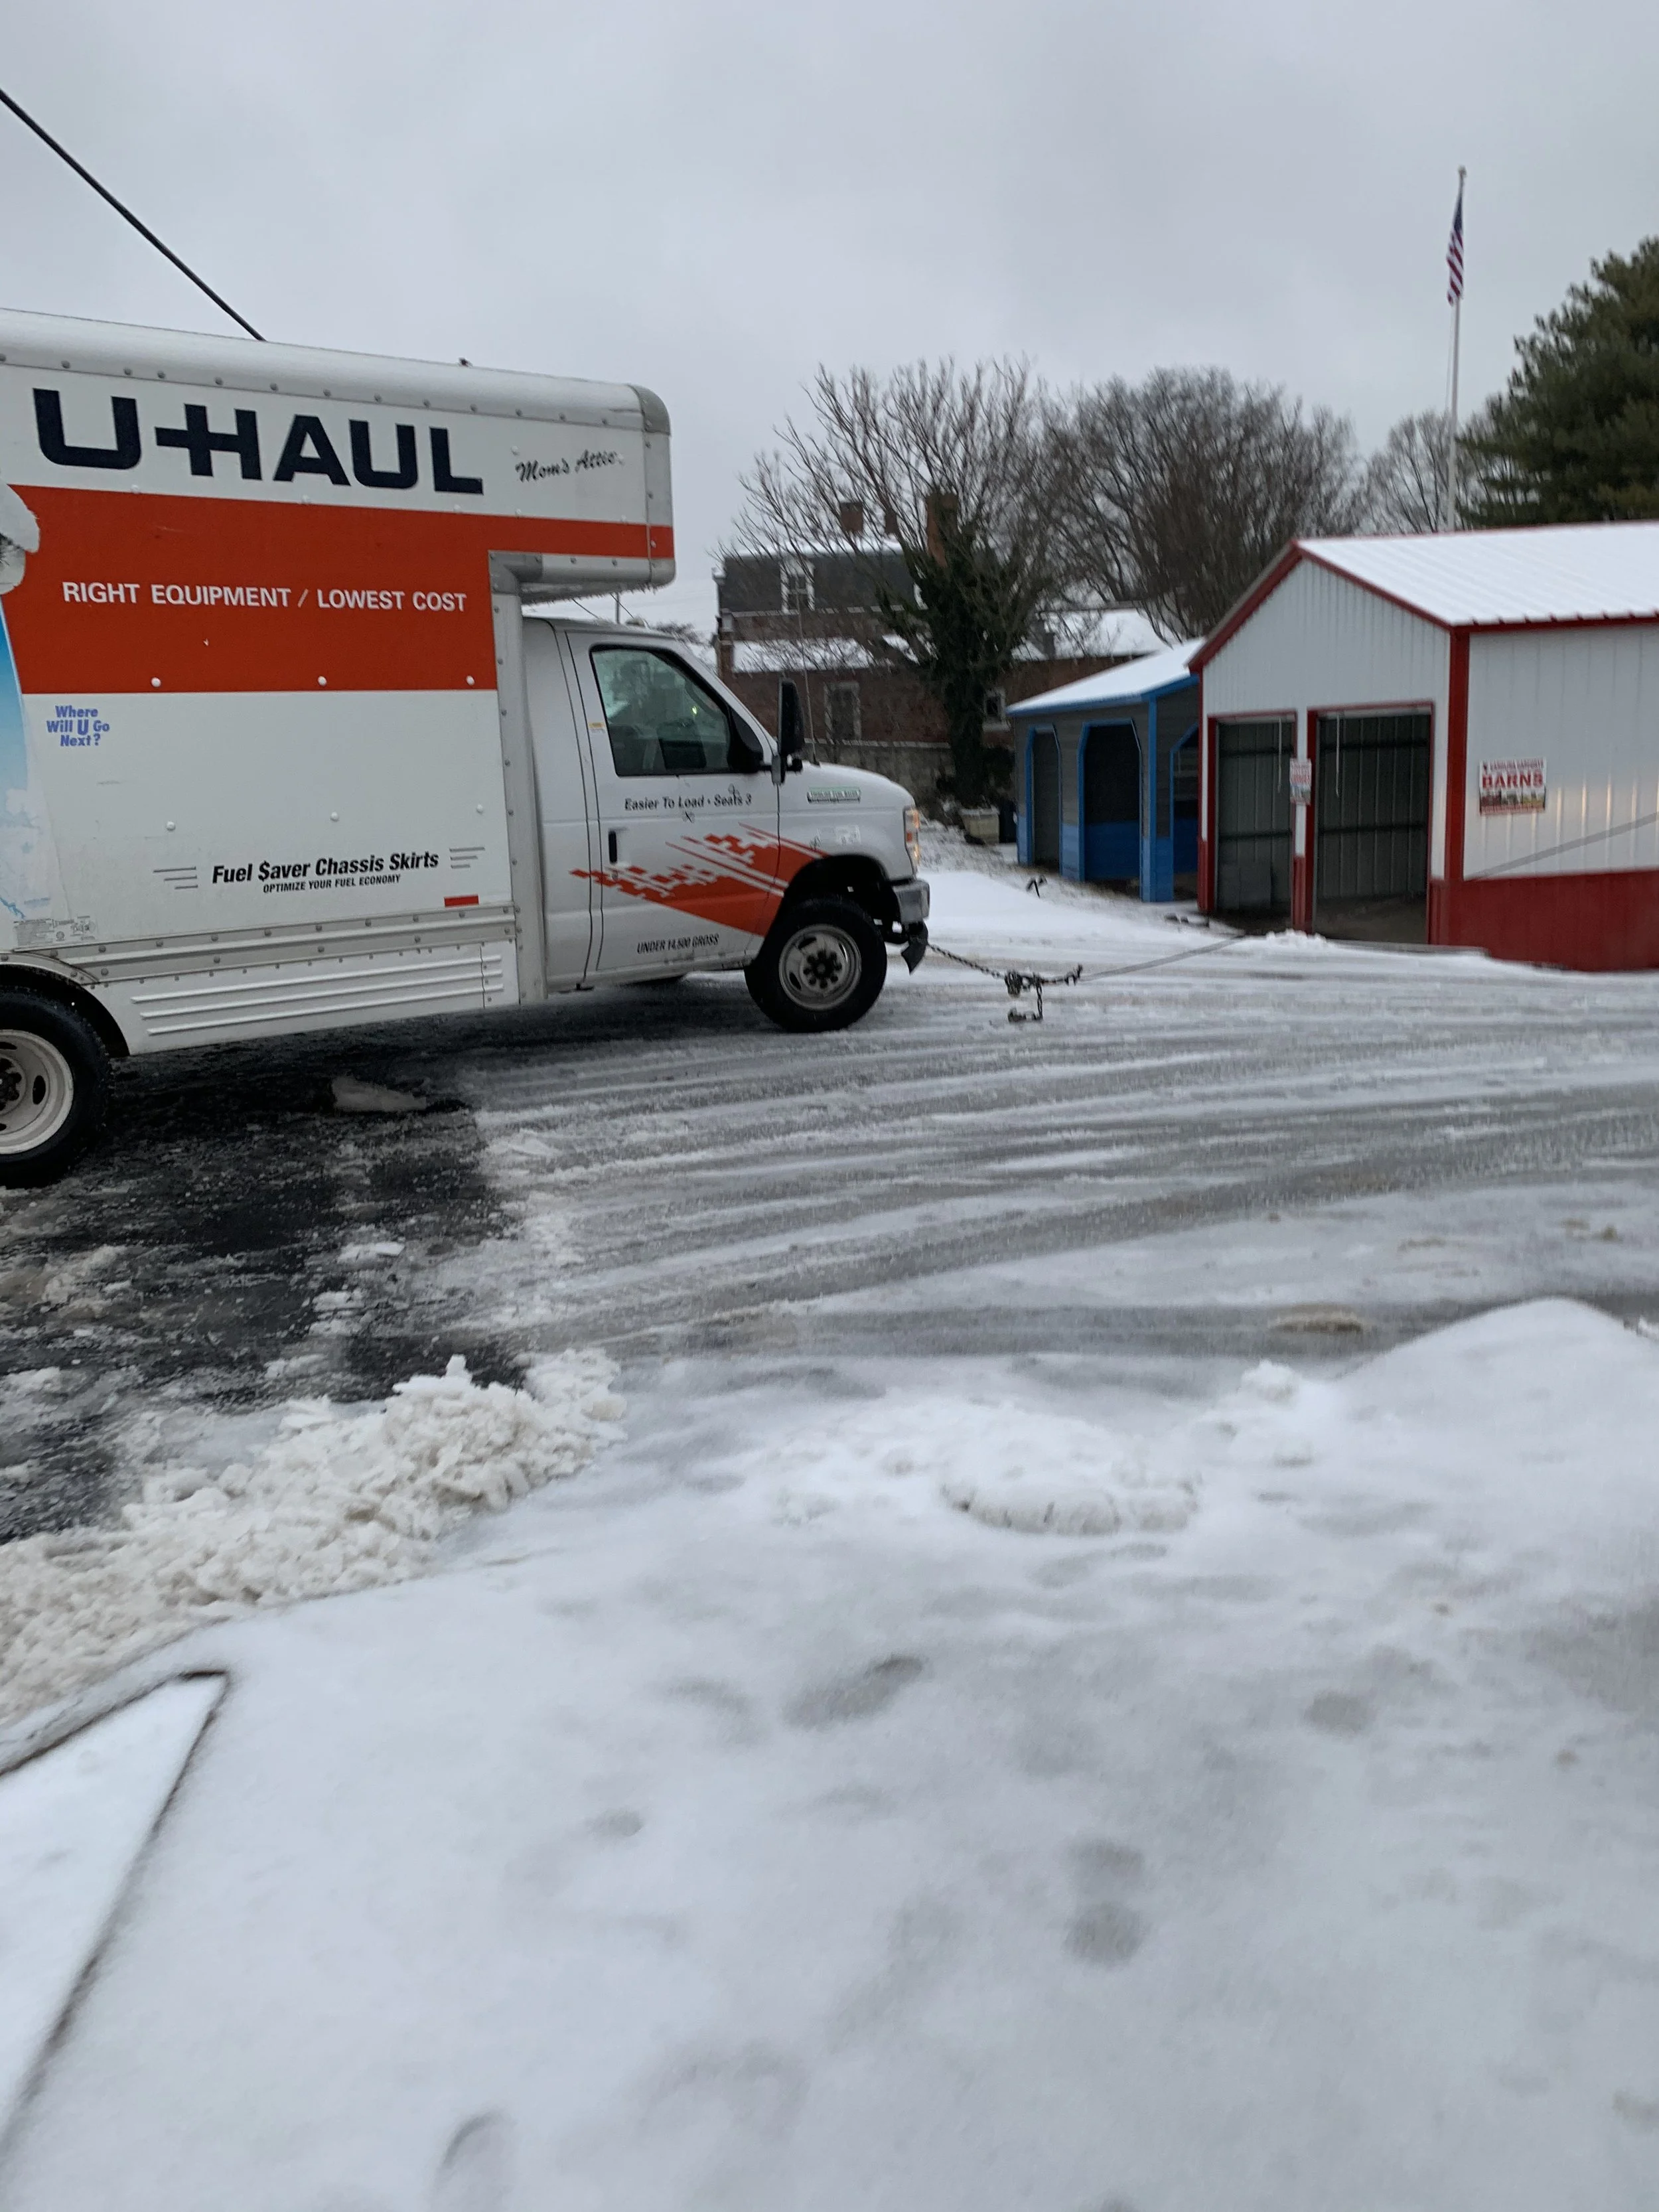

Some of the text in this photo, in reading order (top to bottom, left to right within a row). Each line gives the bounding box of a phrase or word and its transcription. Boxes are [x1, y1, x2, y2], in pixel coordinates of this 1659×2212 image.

[33, 388, 484, 495] U-HAUL
[62, 581, 141, 604] RIGHT
[150, 583, 291, 607] EQUIPMENT
[317, 589, 405, 611] LOWEST
[411, 591, 468, 613] COST
[55, 704, 98, 718] Where
[46, 718, 110, 735] Will U Go
[60, 733, 101, 747] Next?
[1481, 771, 1544, 790] BARNS
[624, 797, 659, 812] Easier
[662, 796, 676, 809] To
[678, 794, 705, 809] Load
[713, 793, 743, 808] Seats
[212, 850, 439, 884] Fuel $aver Chassis Skirts
[263, 873, 401, 893] OPTIMIZE YOUR FUEL ECONOMY
[637, 938, 666, 954] UNDER
[692, 932, 719, 948] GROSS
